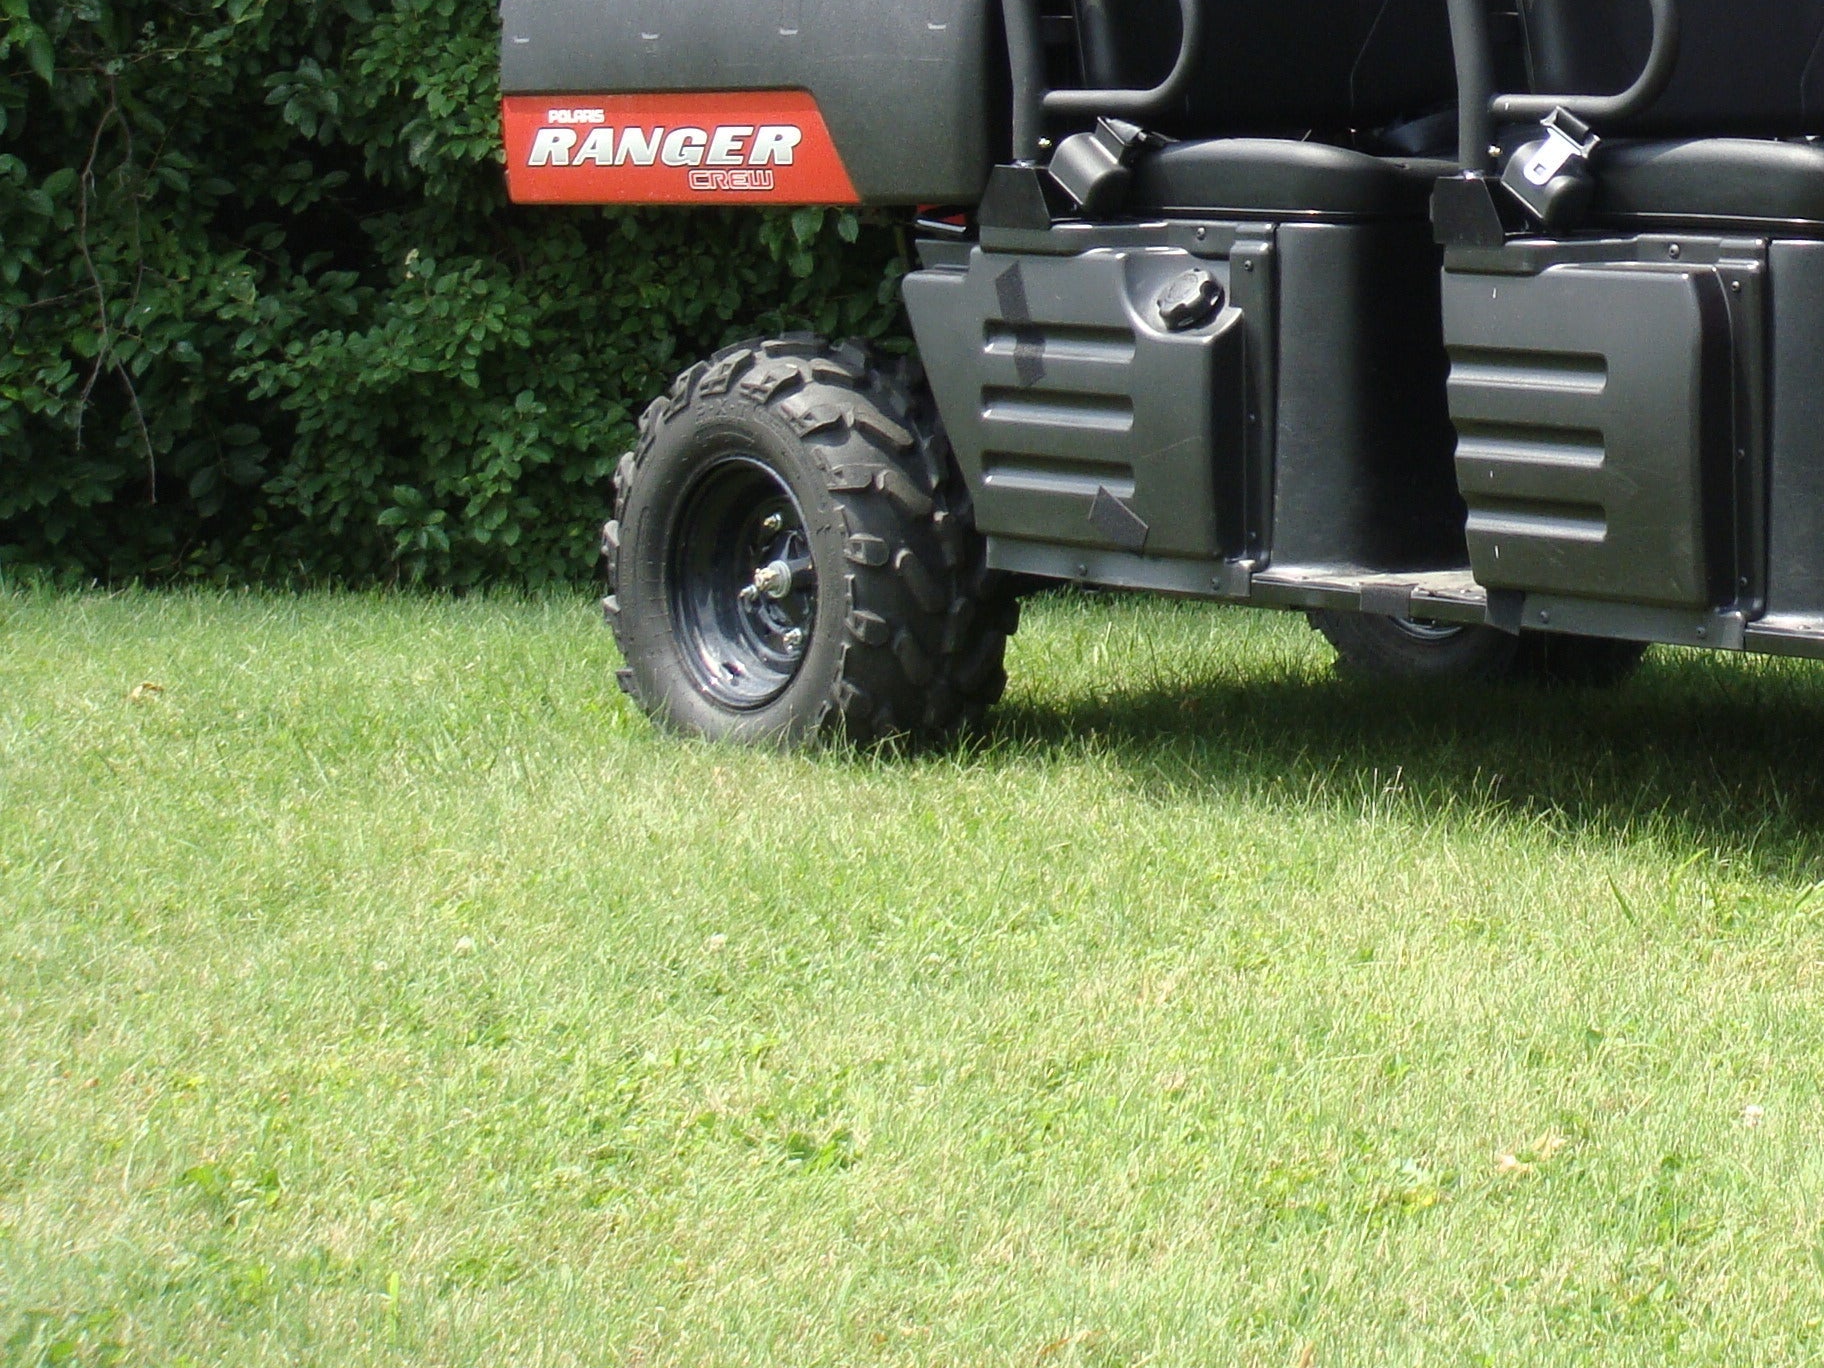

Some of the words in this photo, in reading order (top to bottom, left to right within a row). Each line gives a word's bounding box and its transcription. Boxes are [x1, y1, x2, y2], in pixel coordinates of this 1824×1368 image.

[548, 109, 605, 124] POLARIS
[527, 125, 802, 167] RANGER
[688, 169, 774, 190] CREW
